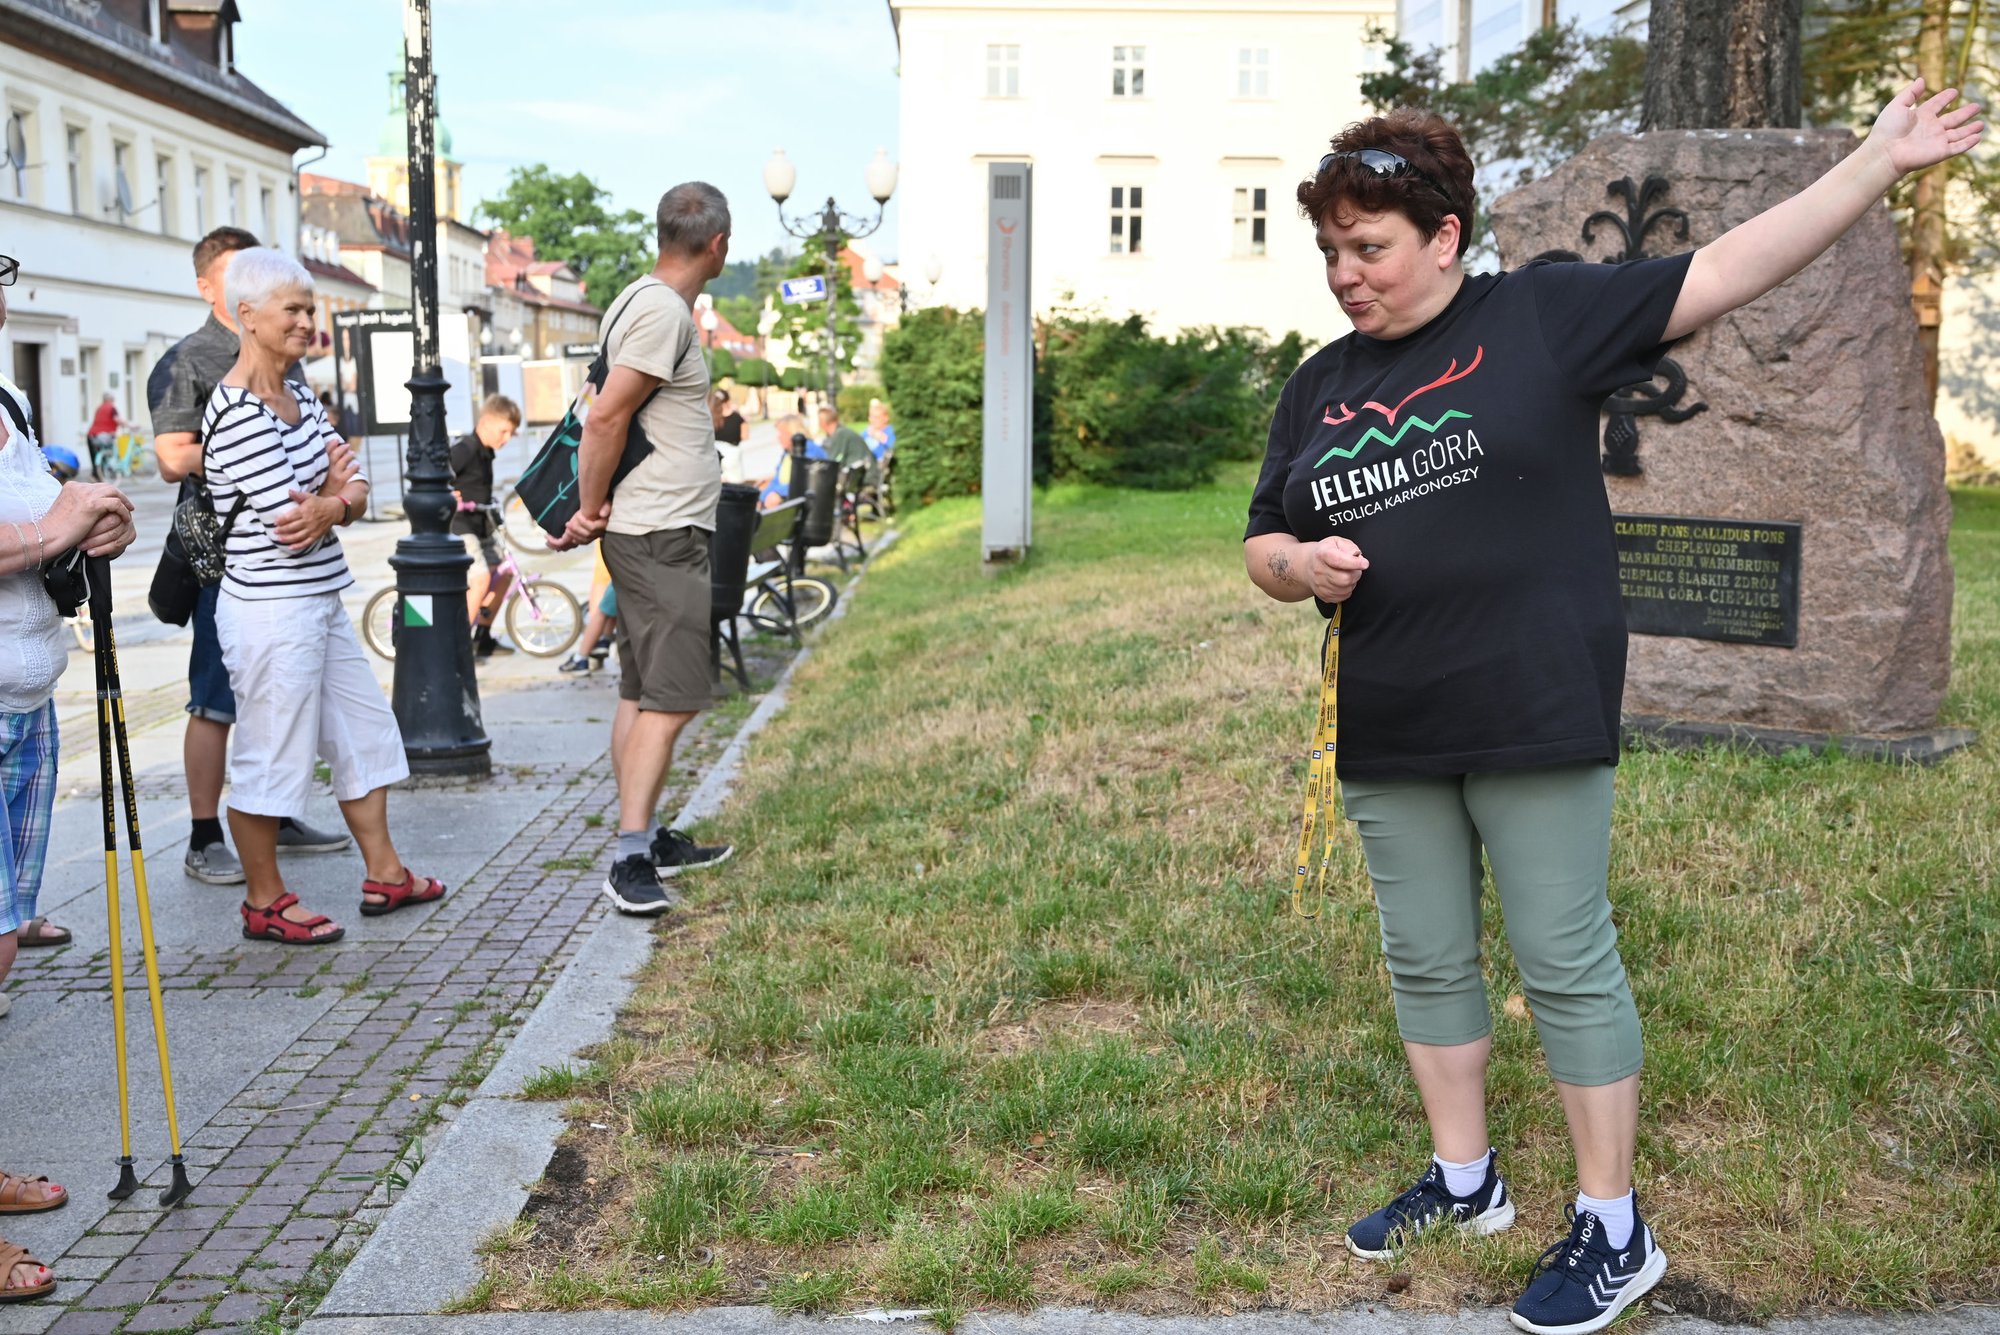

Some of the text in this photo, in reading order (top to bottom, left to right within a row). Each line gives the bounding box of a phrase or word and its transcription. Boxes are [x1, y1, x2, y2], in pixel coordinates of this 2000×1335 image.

[788, 278, 817, 295] WC
[1311, 429, 1484, 512] JELENIA GÓRA
[1328, 466, 1479, 526] STOLICA KARKONOSZY
[1615, 522, 1657, 536] CLARUS
[1693, 527, 1750, 541] CALLIDUS
[1754, 531, 1785, 544] FONS
[1656, 540, 1738, 556] CHEPLEVODE
[1699, 556, 1779, 573] WARMBRUNN
[1619, 568, 1777, 590] CIEPLICE ŚLĄSKIE ZDRÓJ
[1620, 583, 1665, 598] ELENIA
